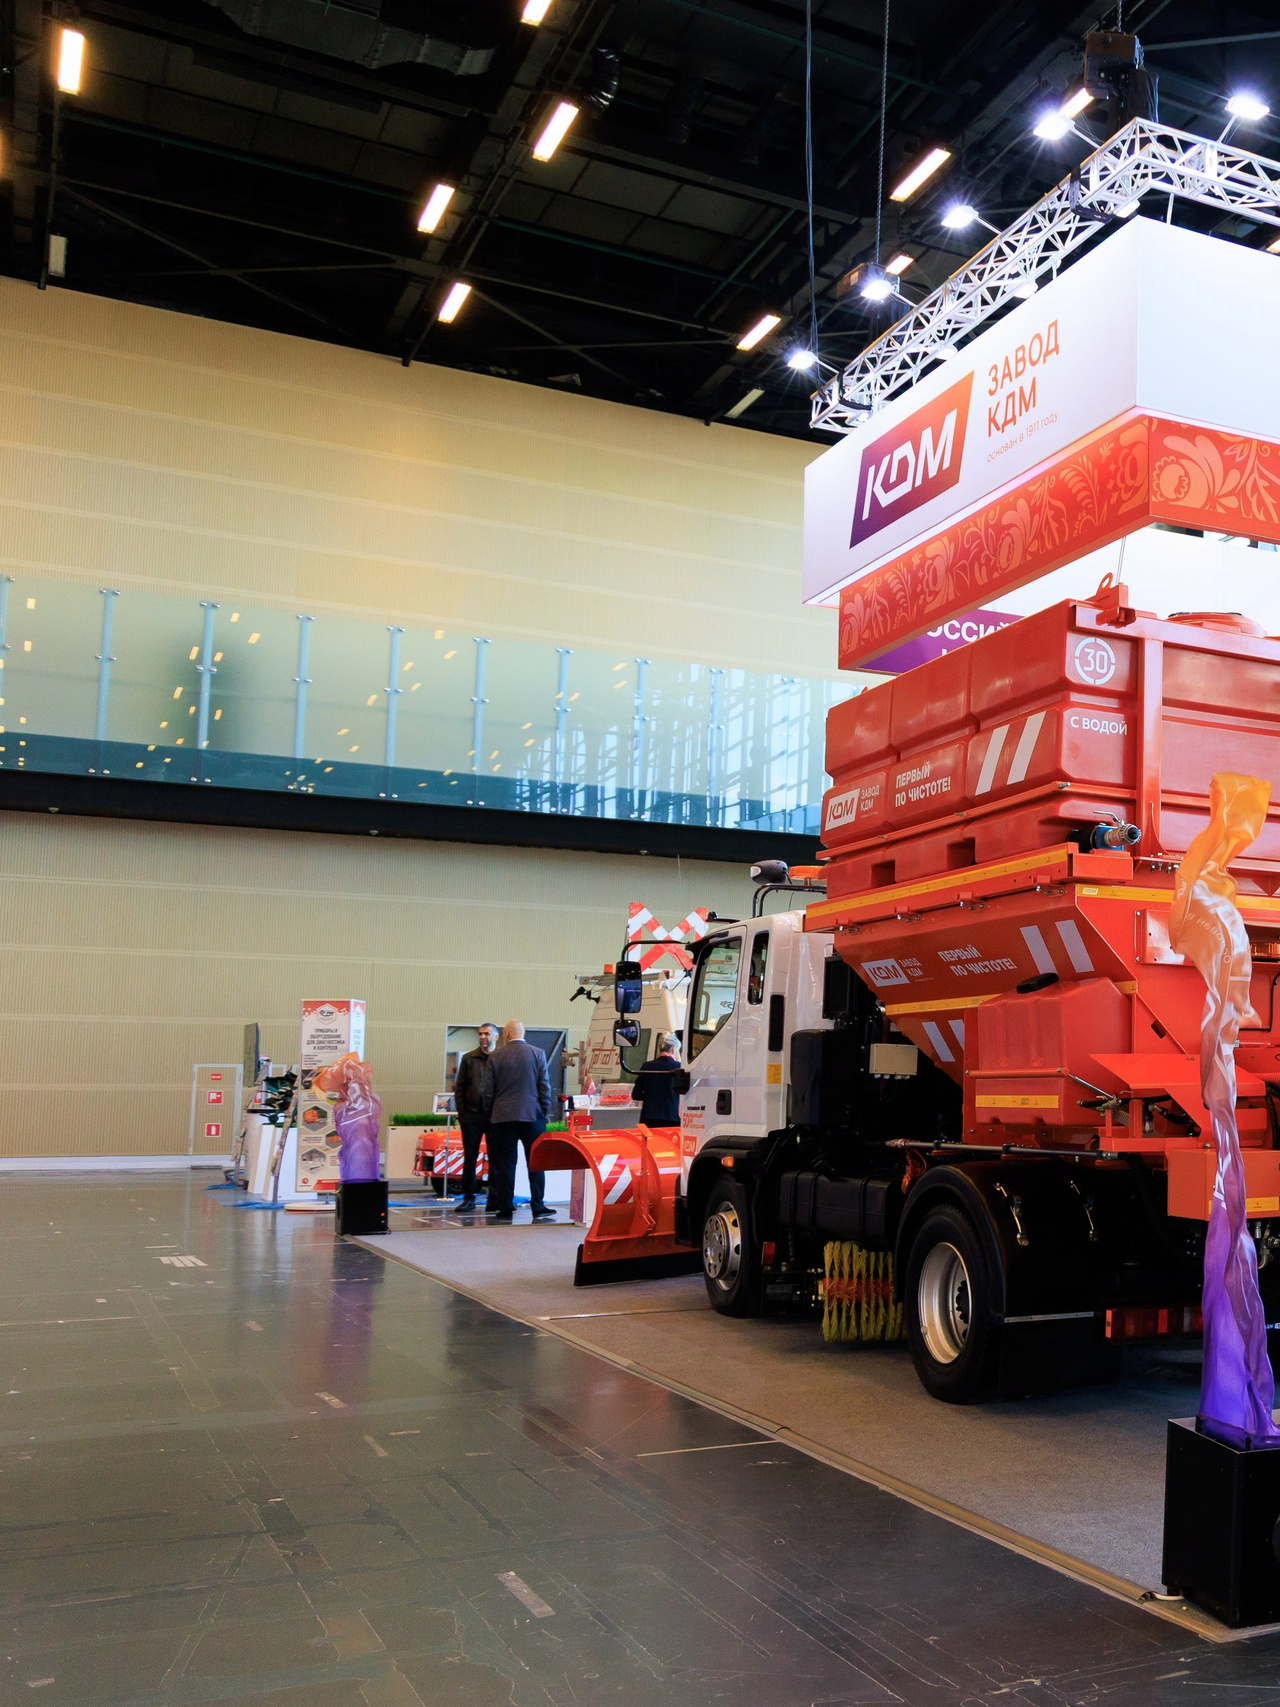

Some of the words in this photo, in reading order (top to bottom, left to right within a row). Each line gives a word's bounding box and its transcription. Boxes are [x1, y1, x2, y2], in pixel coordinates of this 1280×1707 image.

[988, 318, 1060, 396] ЗАВОД
[987, 379, 1037, 438] КДМ
[987, 439, 1018, 463] основан
[1019, 434, 1024, 442] в
[1026, 422, 1040, 437] 1911
[1040, 410, 1059, 428] году
[862, 408, 958, 521] KDM
[1083, 647, 1108, 674] 30
[1070, 715, 1080, 728] С
[1082, 717, 1128, 735] ВОДОЙ
[896, 761, 931, 788] ПЕРВЫЙ
[861, 784, 880, 799] ЗАВОД
[895, 793, 906, 808] ПО
[908, 776, 951, 802] ЧИСТОТЕ!
[860, 799, 874, 812] КДМ
[937, 944, 982, 962] ПЕРВЫЙ
[950, 964, 969, 977] ПО
[966, 957, 1018, 975] ЧИСТОТЕ!
